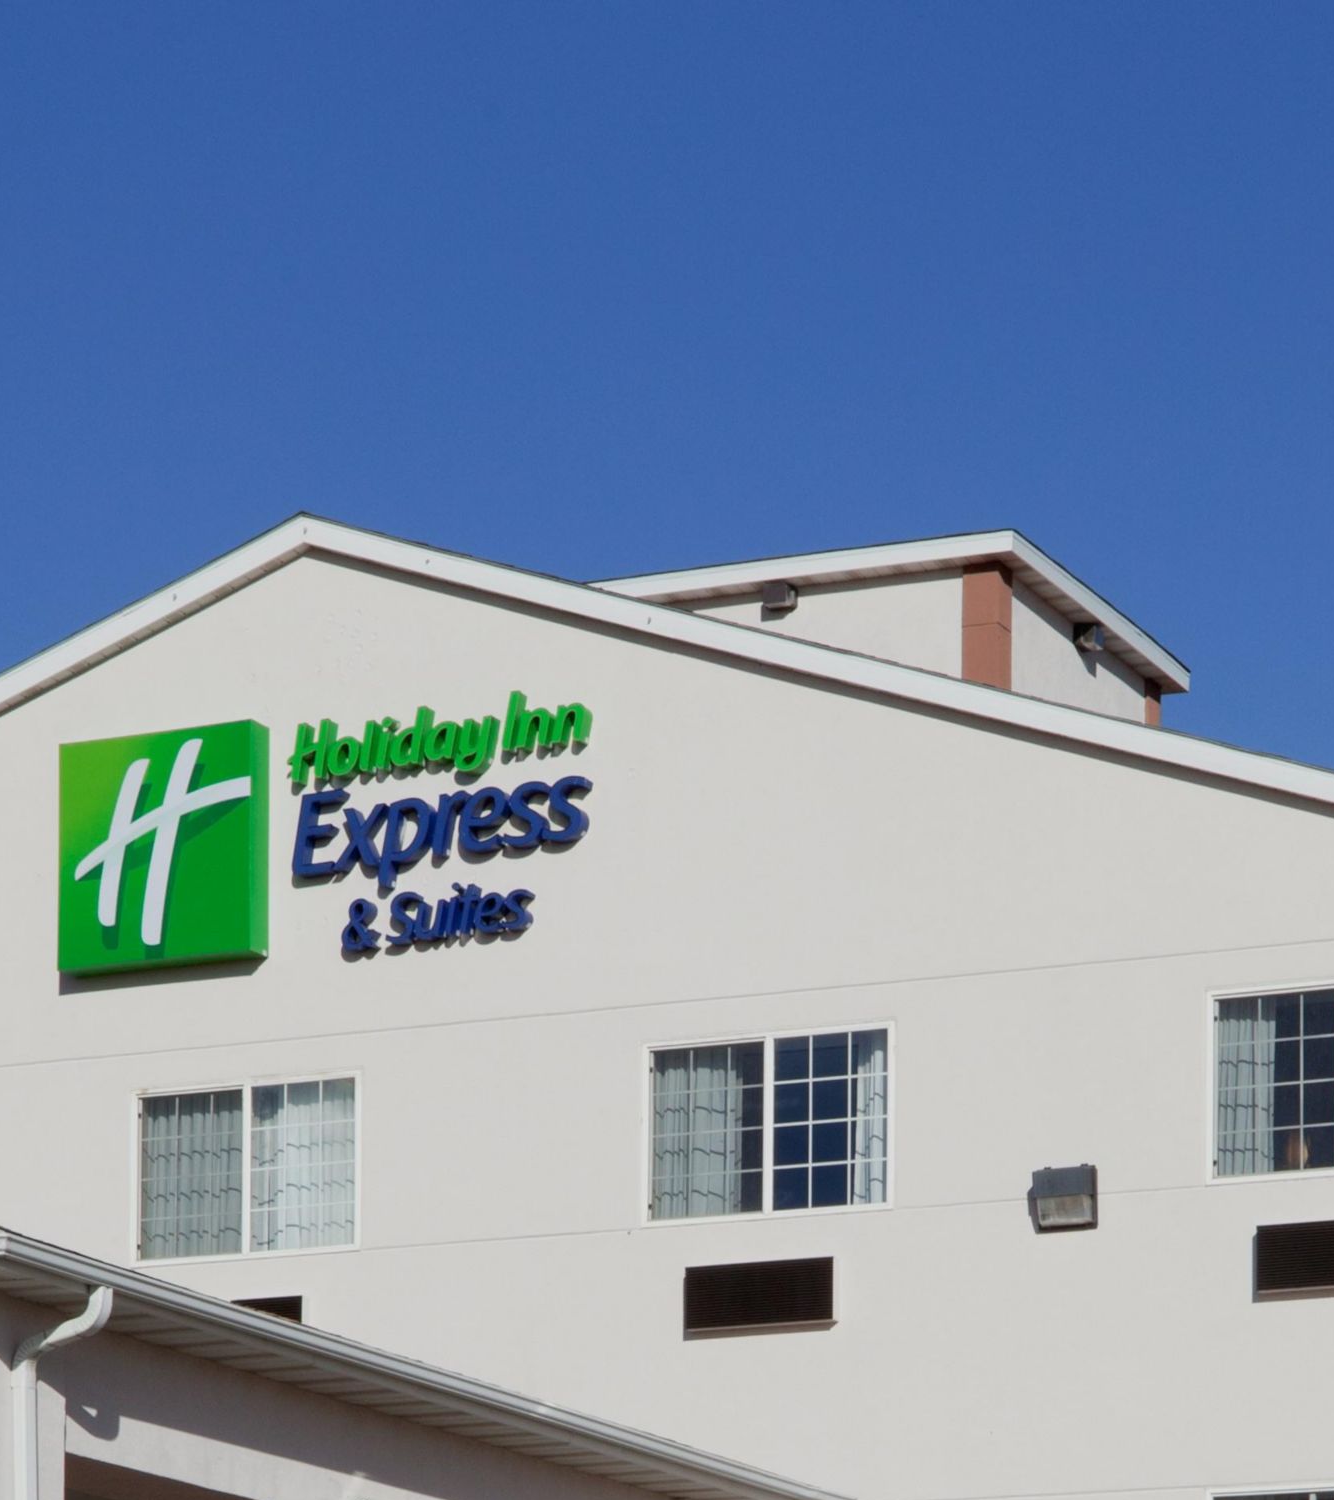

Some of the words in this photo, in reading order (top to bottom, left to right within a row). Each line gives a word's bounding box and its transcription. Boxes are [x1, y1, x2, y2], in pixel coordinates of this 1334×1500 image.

[287, 705, 499, 786] Holiday
[501, 690, 593, 754] Inn
[291, 775, 593, 893] Express
[341, 898, 380, 955] &
[386, 882, 535, 947] Suites
